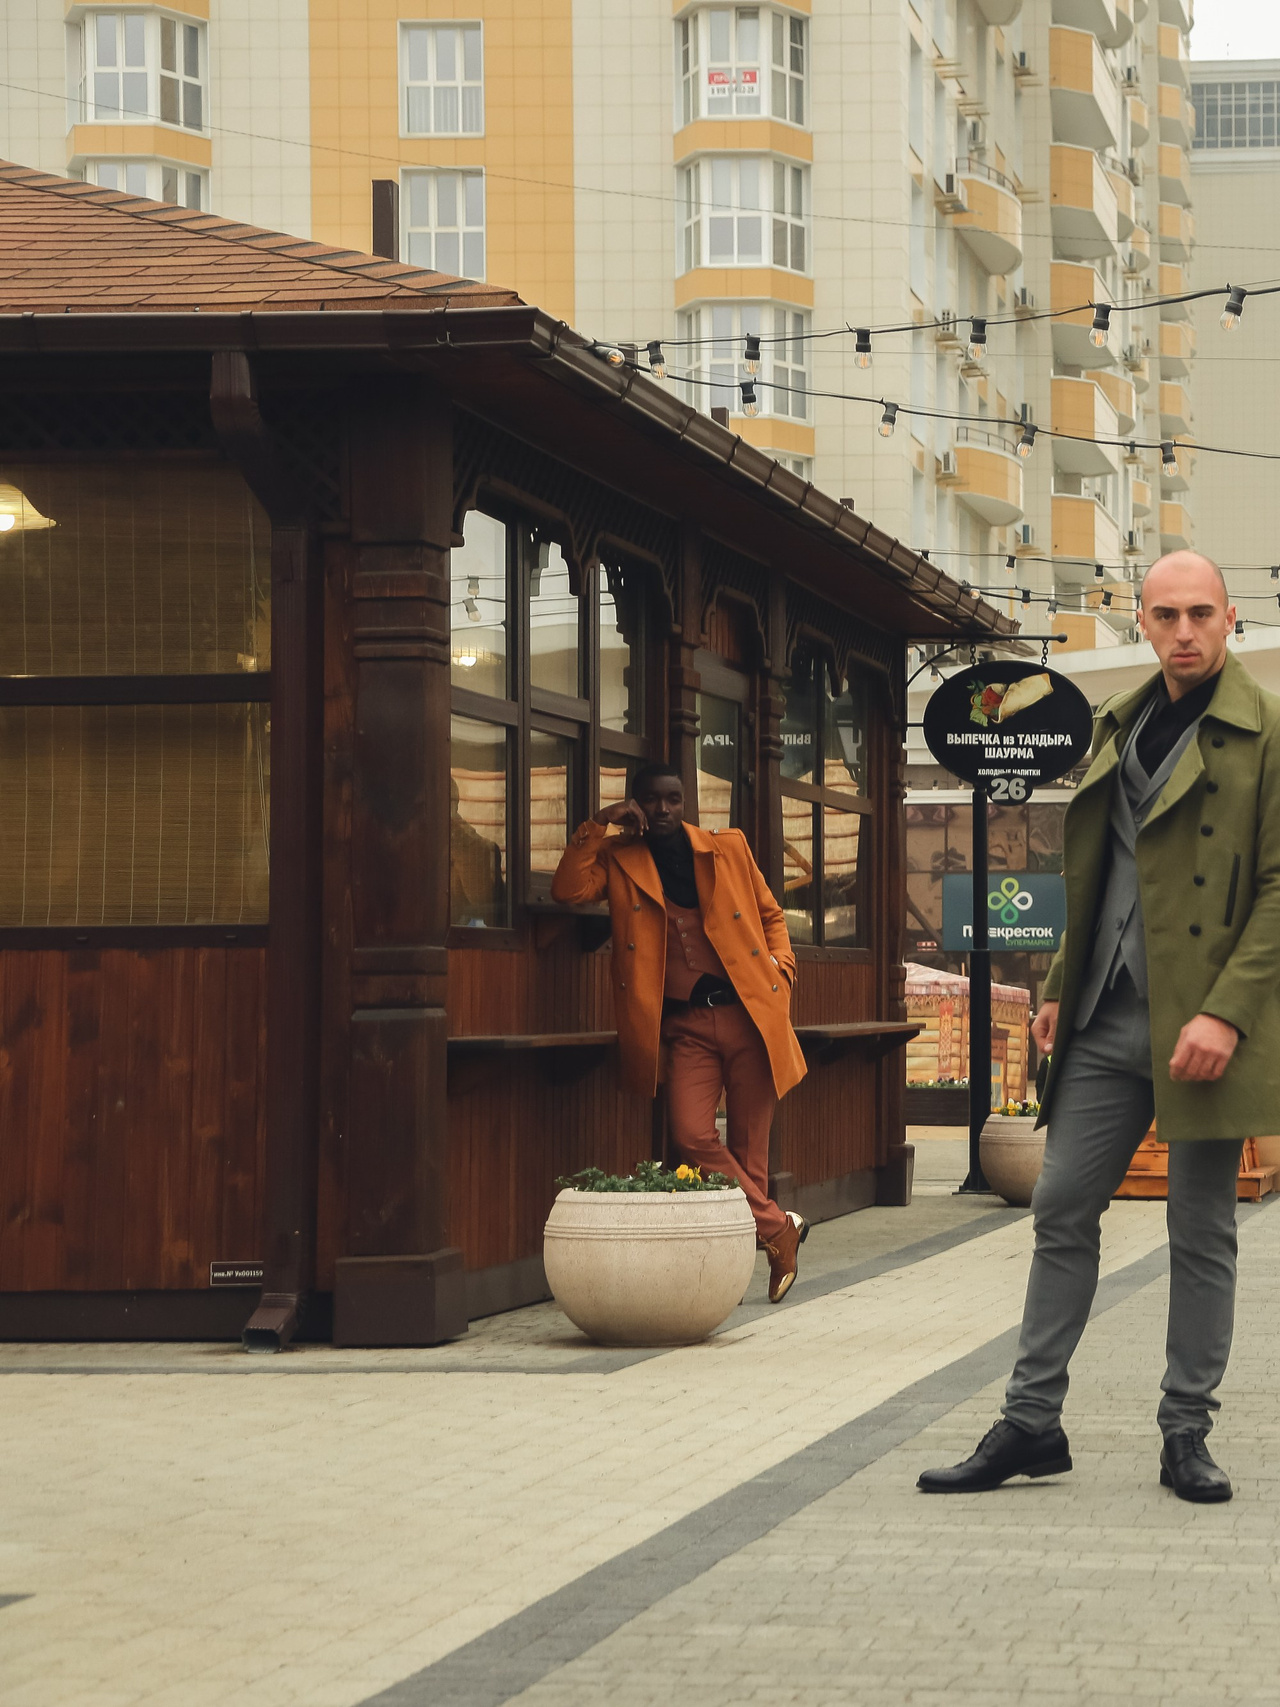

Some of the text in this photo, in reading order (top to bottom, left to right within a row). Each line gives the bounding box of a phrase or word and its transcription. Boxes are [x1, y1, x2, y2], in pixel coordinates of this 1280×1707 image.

[946, 733, 1072, 747] ВЫПЕЧКА из ТАНДЫРА
[984, 747, 1034, 759] ШАУРМА
[1012, 768, 1041, 776] НАПИТКИ
[990, 777, 1026, 800] 26
[962, 924, 1054, 940] Пекресток
